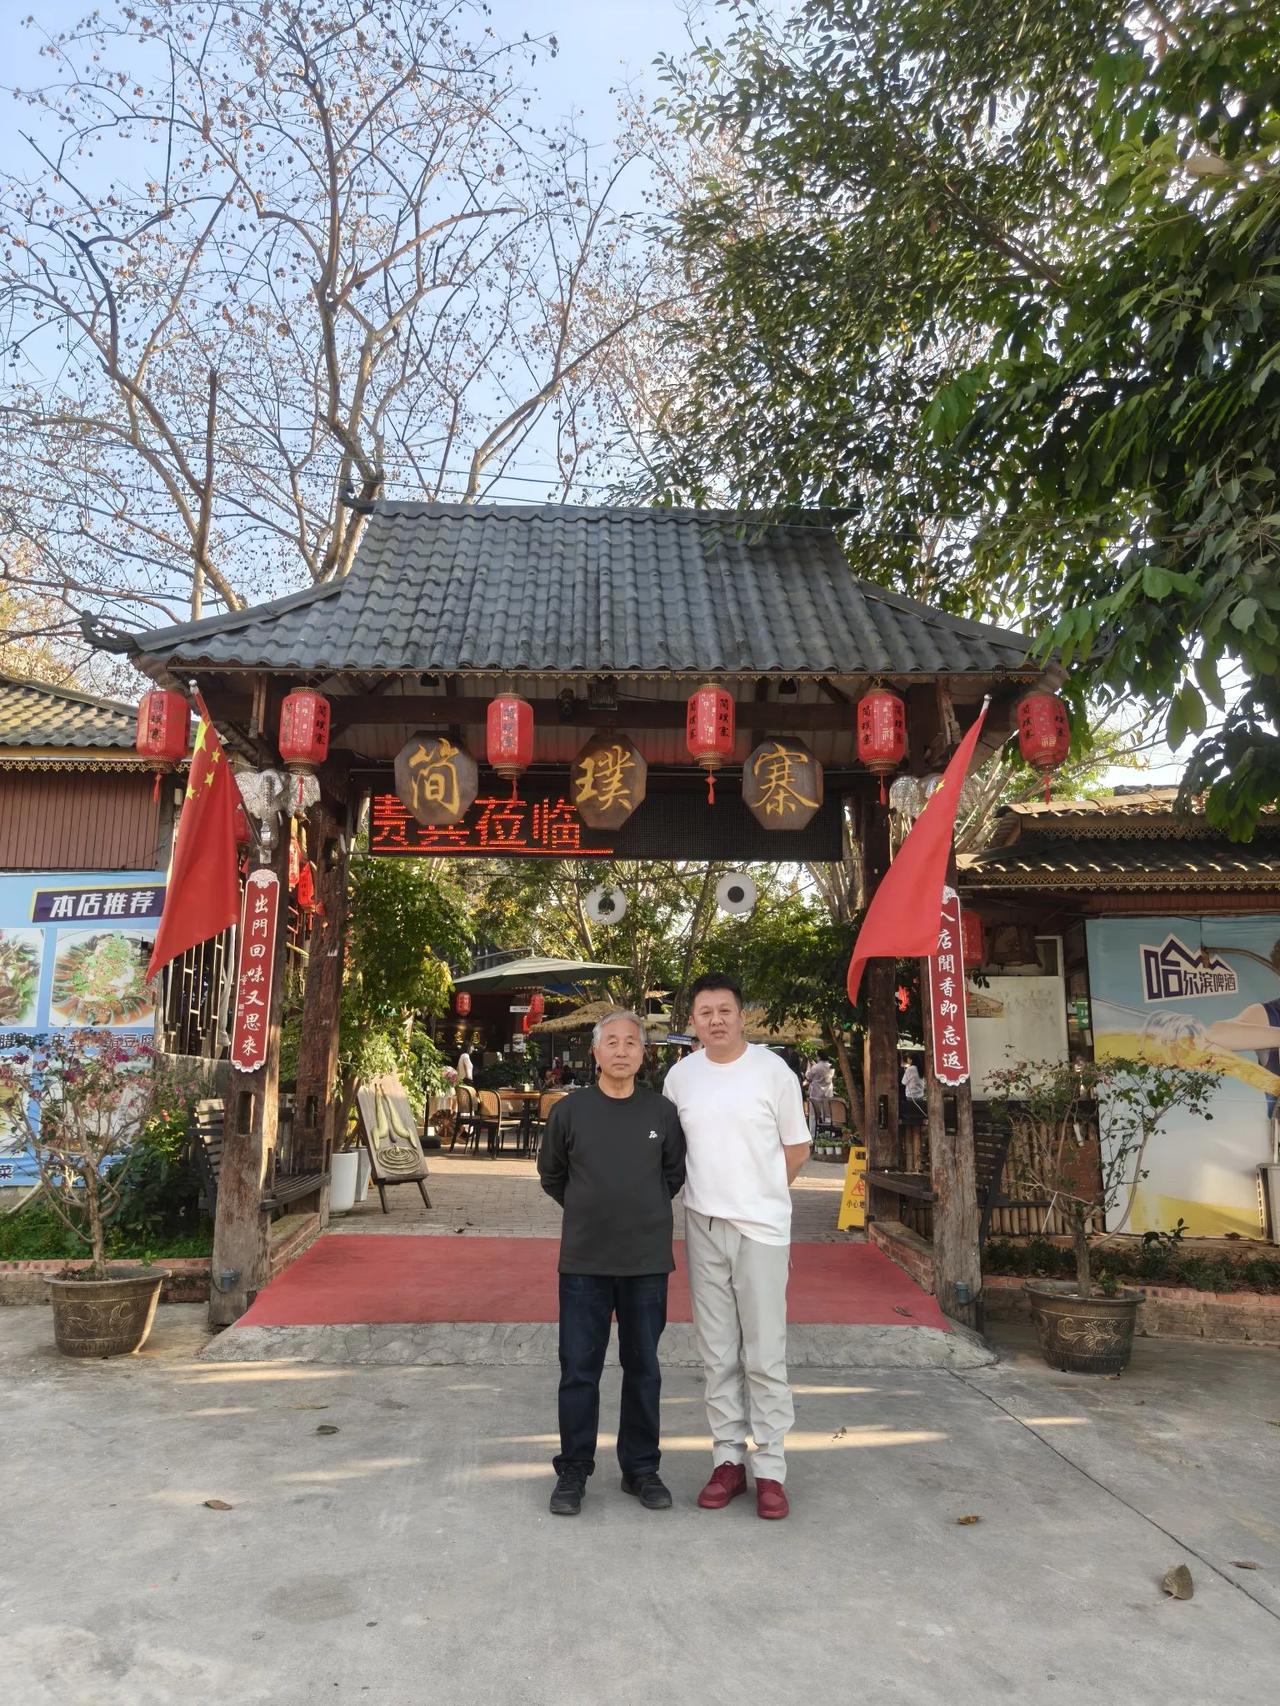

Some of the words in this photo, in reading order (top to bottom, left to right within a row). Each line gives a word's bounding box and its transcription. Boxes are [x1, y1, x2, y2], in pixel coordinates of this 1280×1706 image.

[50, 891, 156, 918] 本店推荐
[242, 893, 269, 1056] 出門回味又思來
[1143, 938, 1236, 1000] 哈尔滨啤酒
